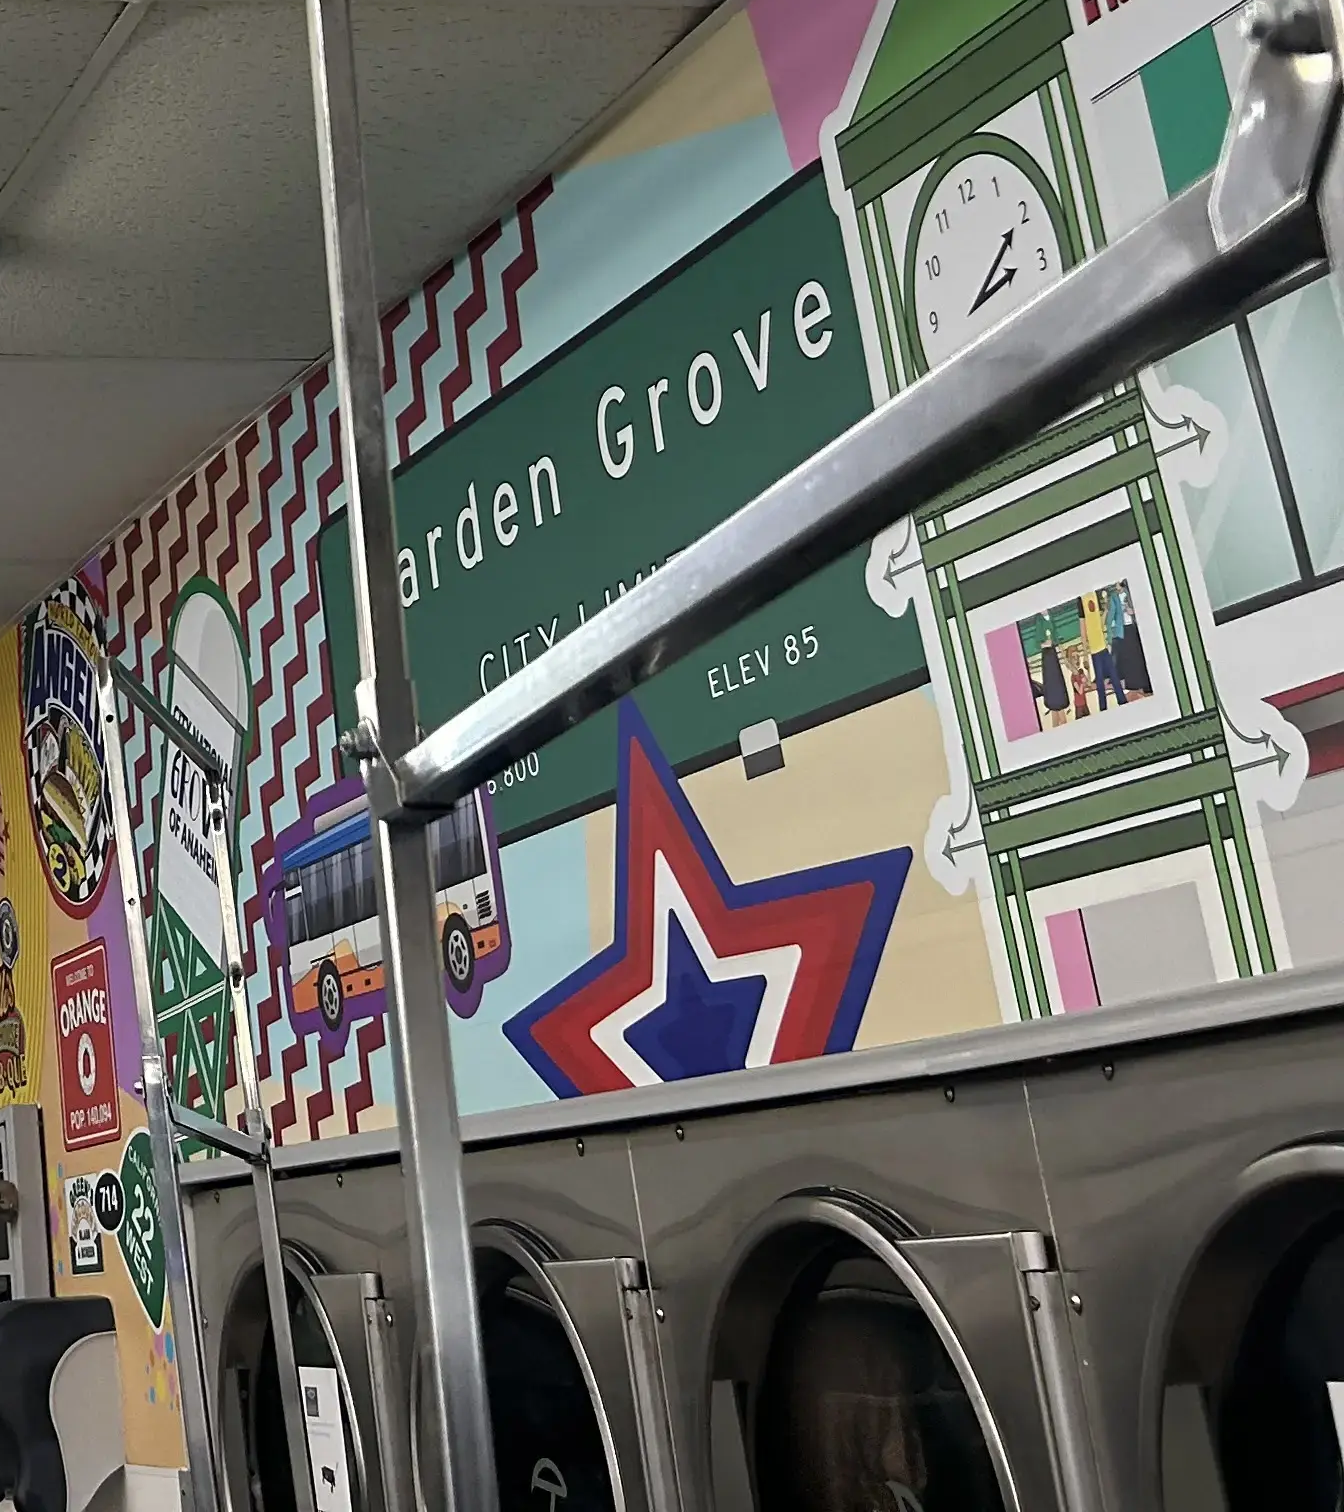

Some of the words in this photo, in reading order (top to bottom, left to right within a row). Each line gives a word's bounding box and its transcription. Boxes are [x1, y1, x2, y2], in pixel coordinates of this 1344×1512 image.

[958, 178, 975, 204] 12
[991, 176, 1000, 197] 1
[935, 209, 949, 233] 11
[1017, 200, 1030, 224] 2
[925, 255, 941, 280] 10
[1036, 247, 1047, 271] 3
[929, 311, 938, 334] 9
[398, 455, 562, 609] arden
[595, 279, 835, 480] Grove
[707, 644, 769, 699] ELEV
[783, 625, 819, 666] 85
[169, 807, 180, 839] OF
[60, 987, 107, 1038] ORANGE
[100, 1184, 118, 1213] 714
[131, 1183, 155, 1261] 22
[125, 1219, 155, 1296] WEST
